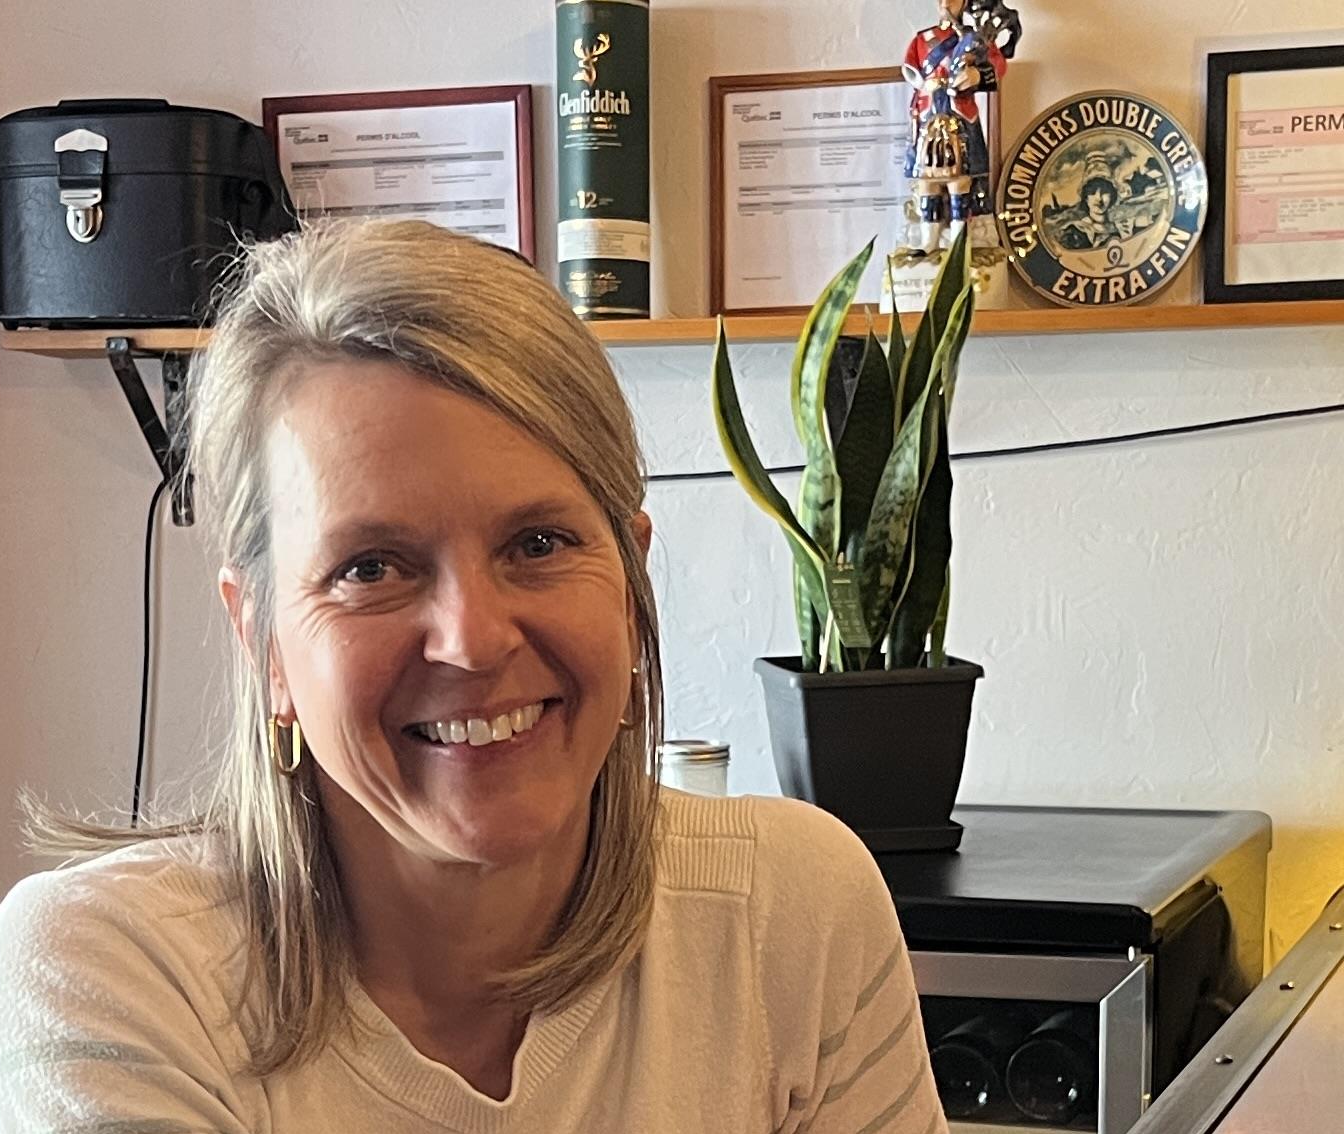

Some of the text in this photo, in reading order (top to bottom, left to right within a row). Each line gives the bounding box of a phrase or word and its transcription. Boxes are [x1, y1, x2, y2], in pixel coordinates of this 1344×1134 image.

[559, 88, 631, 117] Glenfiddich
[1078, 99, 1163, 139] DOUBLE
[576, 190, 598, 210] 12
[1051, 225, 1192, 304] EXTRA FIN
